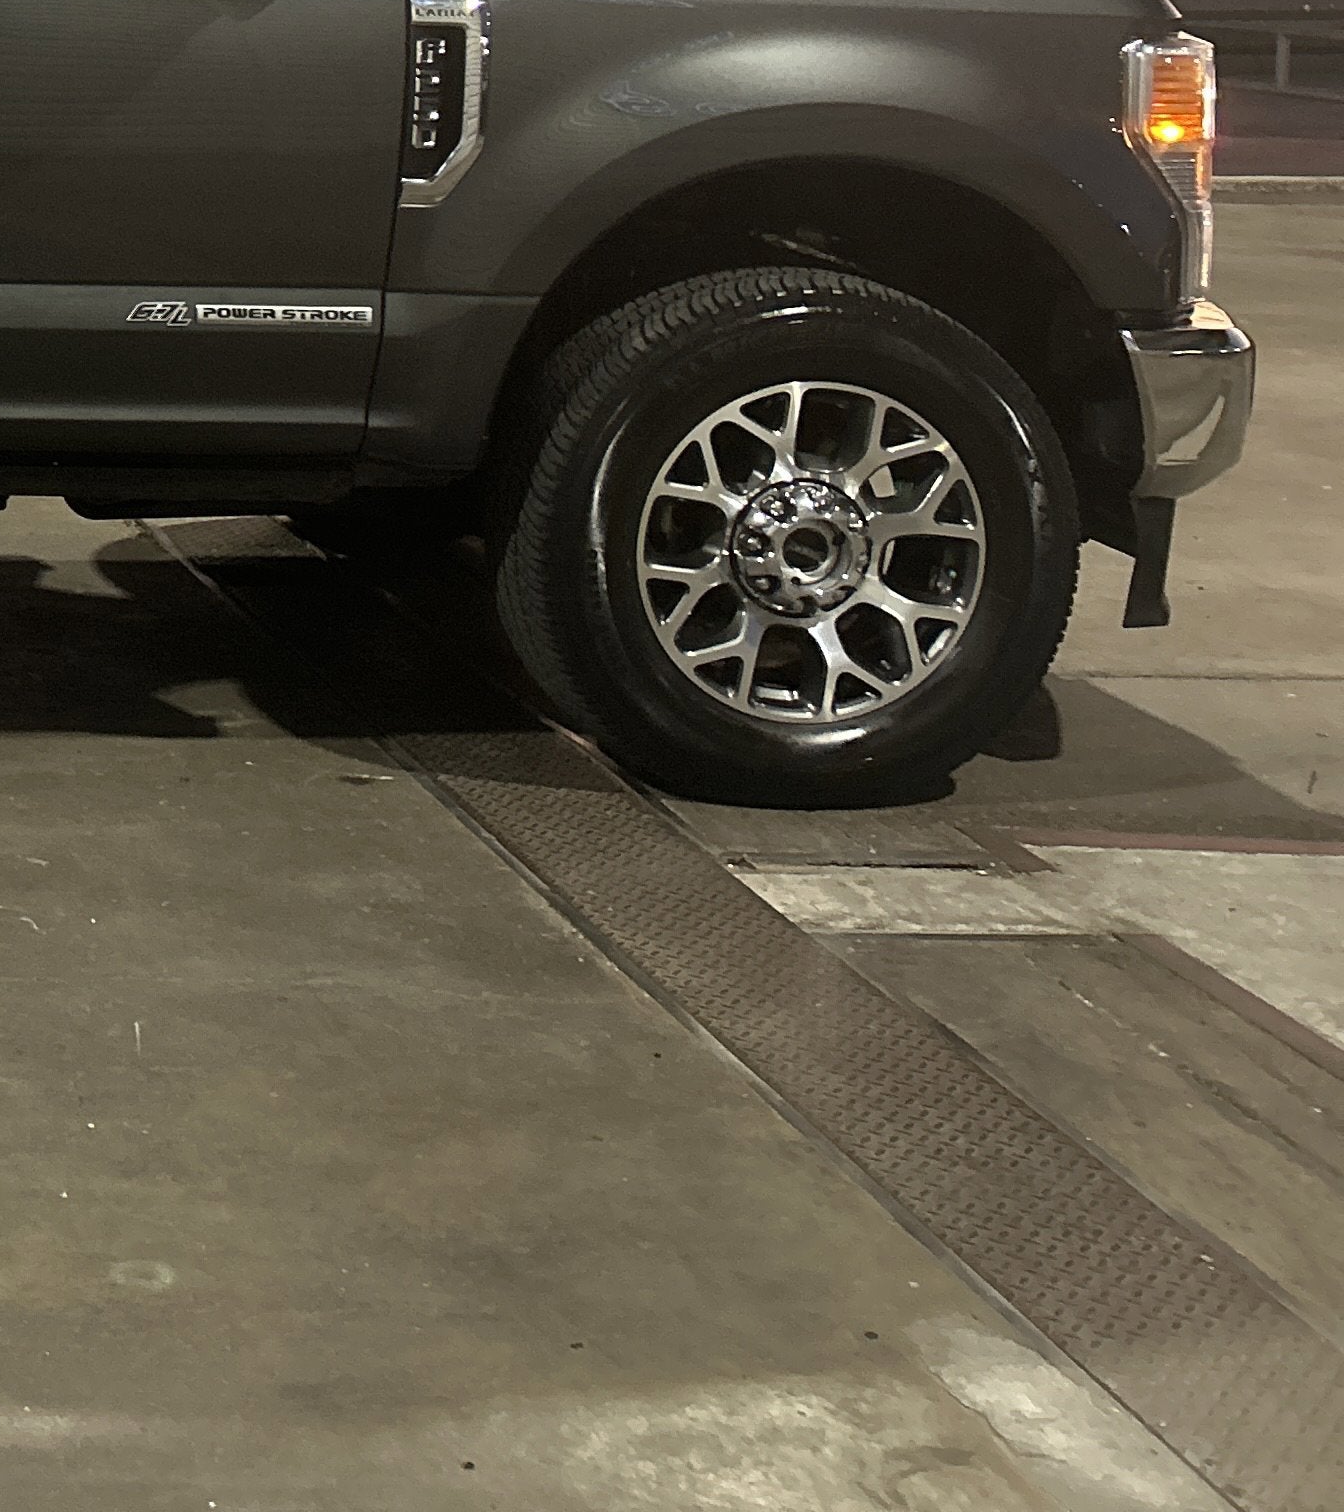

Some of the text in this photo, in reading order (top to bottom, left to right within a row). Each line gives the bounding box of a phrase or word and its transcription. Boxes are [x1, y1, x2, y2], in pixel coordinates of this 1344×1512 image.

[125, 301, 192, 327] 6.7L
[203, 307, 368, 321] POWER STROKE
